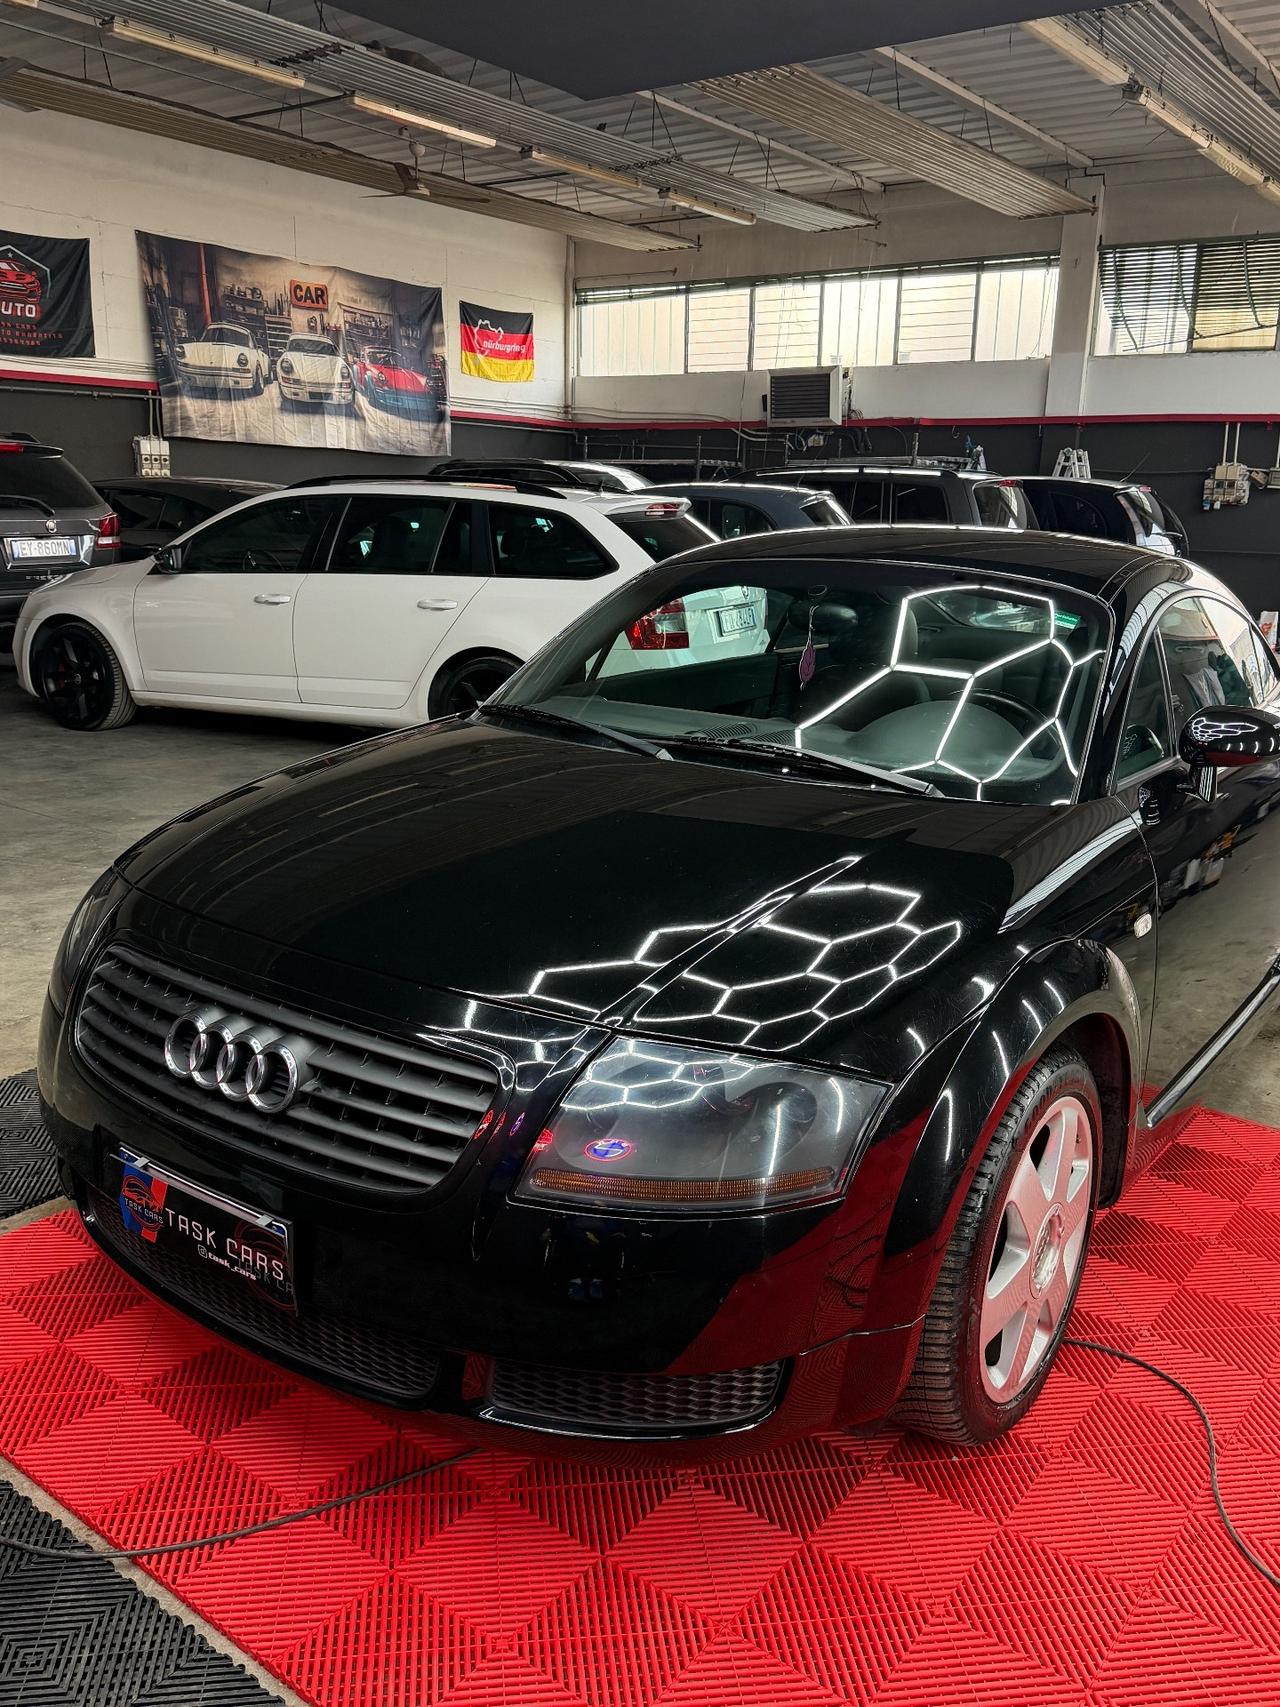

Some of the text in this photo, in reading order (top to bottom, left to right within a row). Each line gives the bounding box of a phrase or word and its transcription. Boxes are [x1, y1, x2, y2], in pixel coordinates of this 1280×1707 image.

[293, 284, 327, 305] CAR
[482, 339, 527, 354] nürburgring
[124, 1198, 164, 1224] TASK CARS
[164, 1207, 284, 1281] TASK CARS
